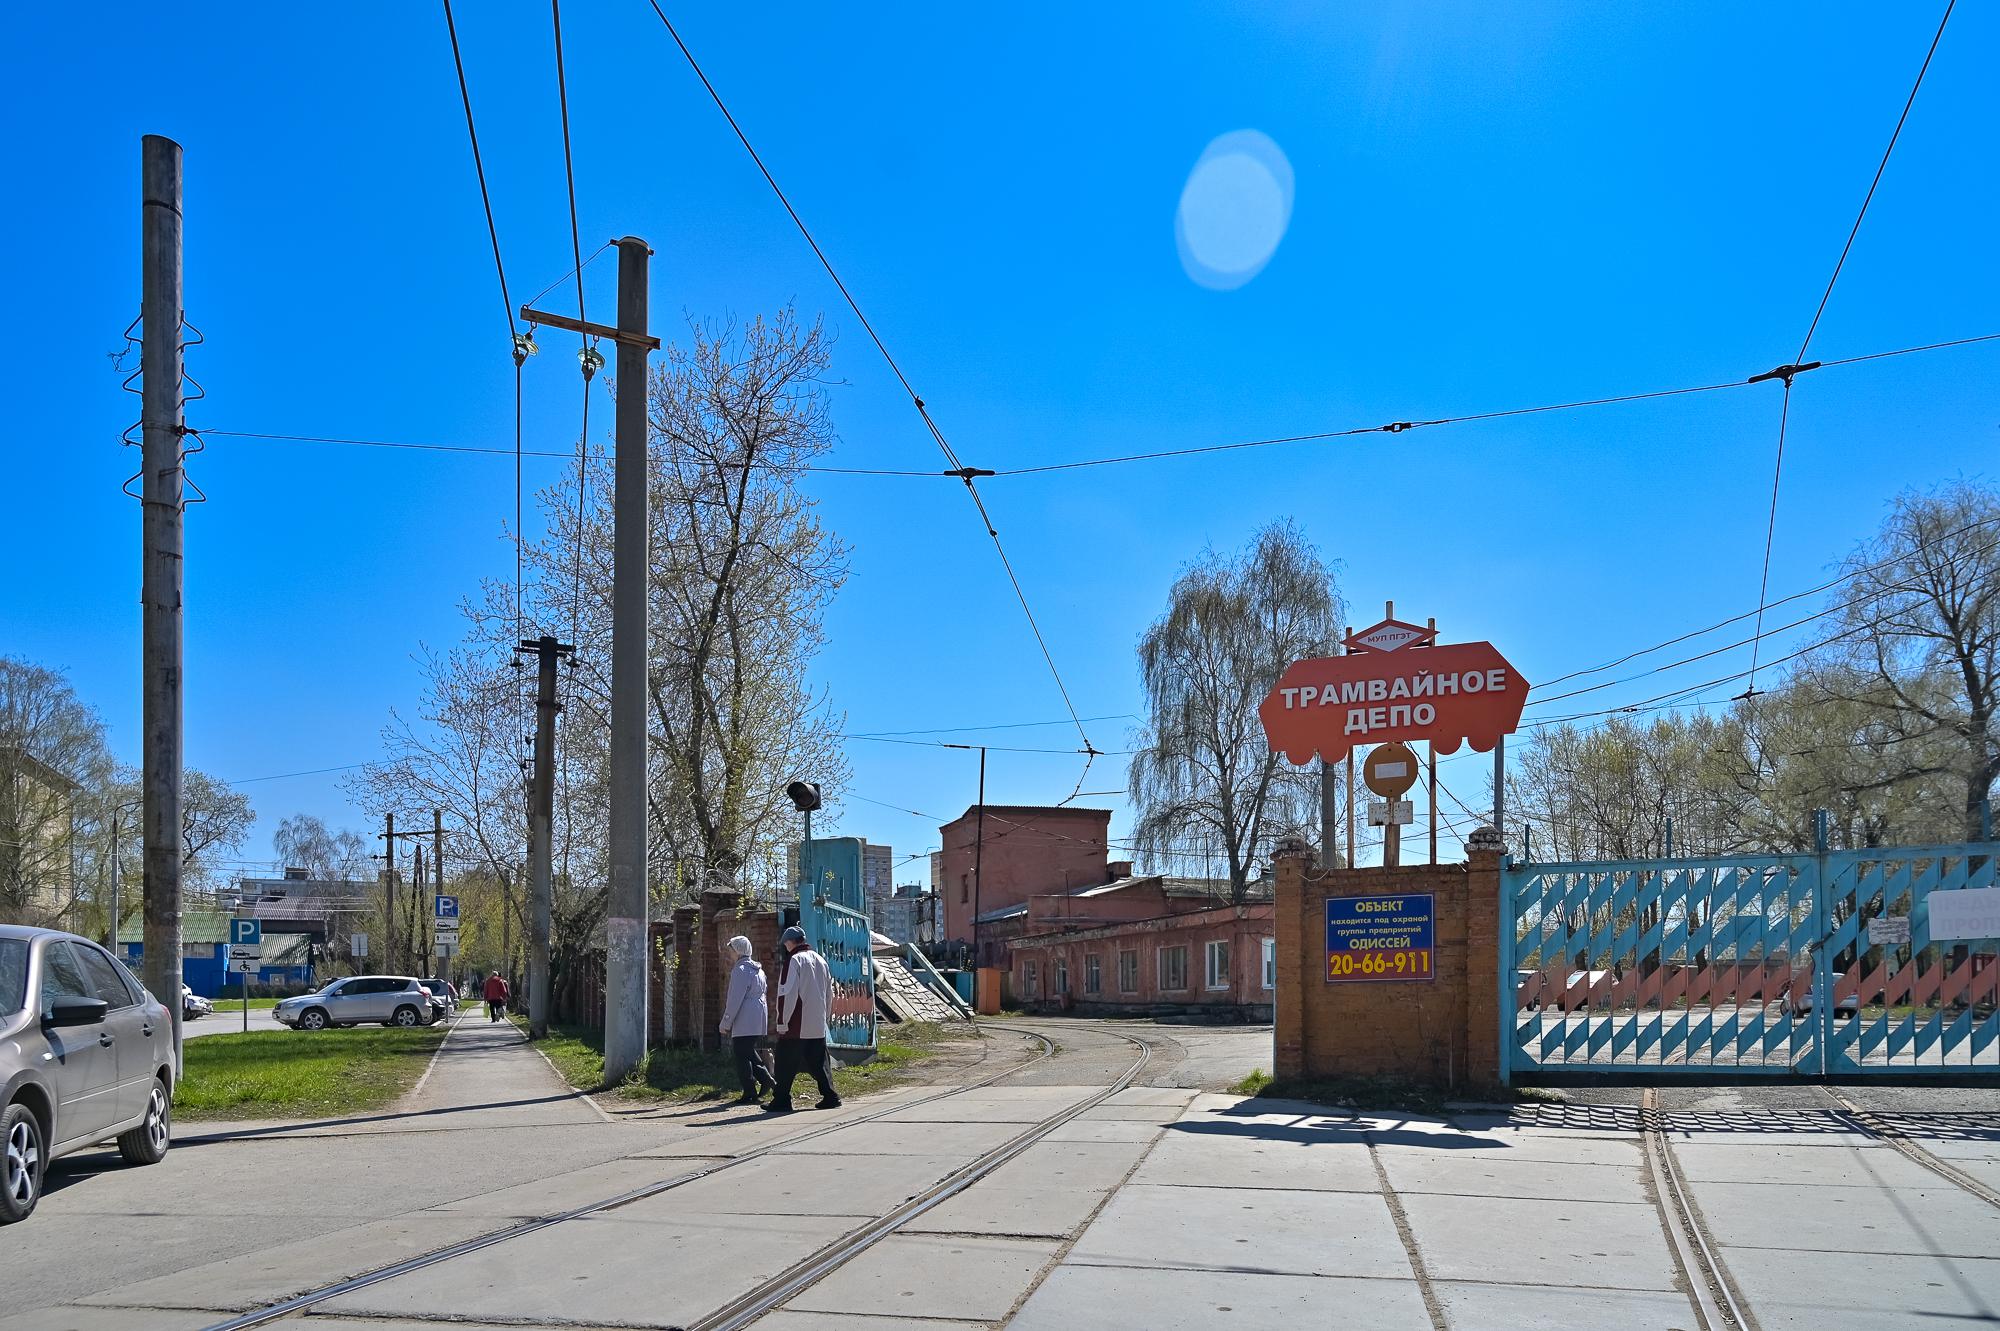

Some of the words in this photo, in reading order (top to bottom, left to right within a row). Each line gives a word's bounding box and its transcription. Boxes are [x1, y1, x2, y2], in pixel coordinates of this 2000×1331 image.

[1367, 634, 1387, 643] МУП
[1389, 632, 1412, 641] ПГЭТ
[1280, 668, 1506, 709] ТРАМВАЙНОЕ
[1344, 703, 1436, 736] ДЕПО
[1355, 900, 1404, 913] ОБЪЕКТ
[1331, 918, 1372, 926] находится
[1392, 915, 1429, 924] охраной
[238, 921, 255, 942] P
[1337, 928, 1366, 937] группы
[1369, 926, 1422, 936] предприятий
[1349, 935, 1411, 950] ОДИССЕЙ
[1330, 951, 1429, 975] 20-66-911
